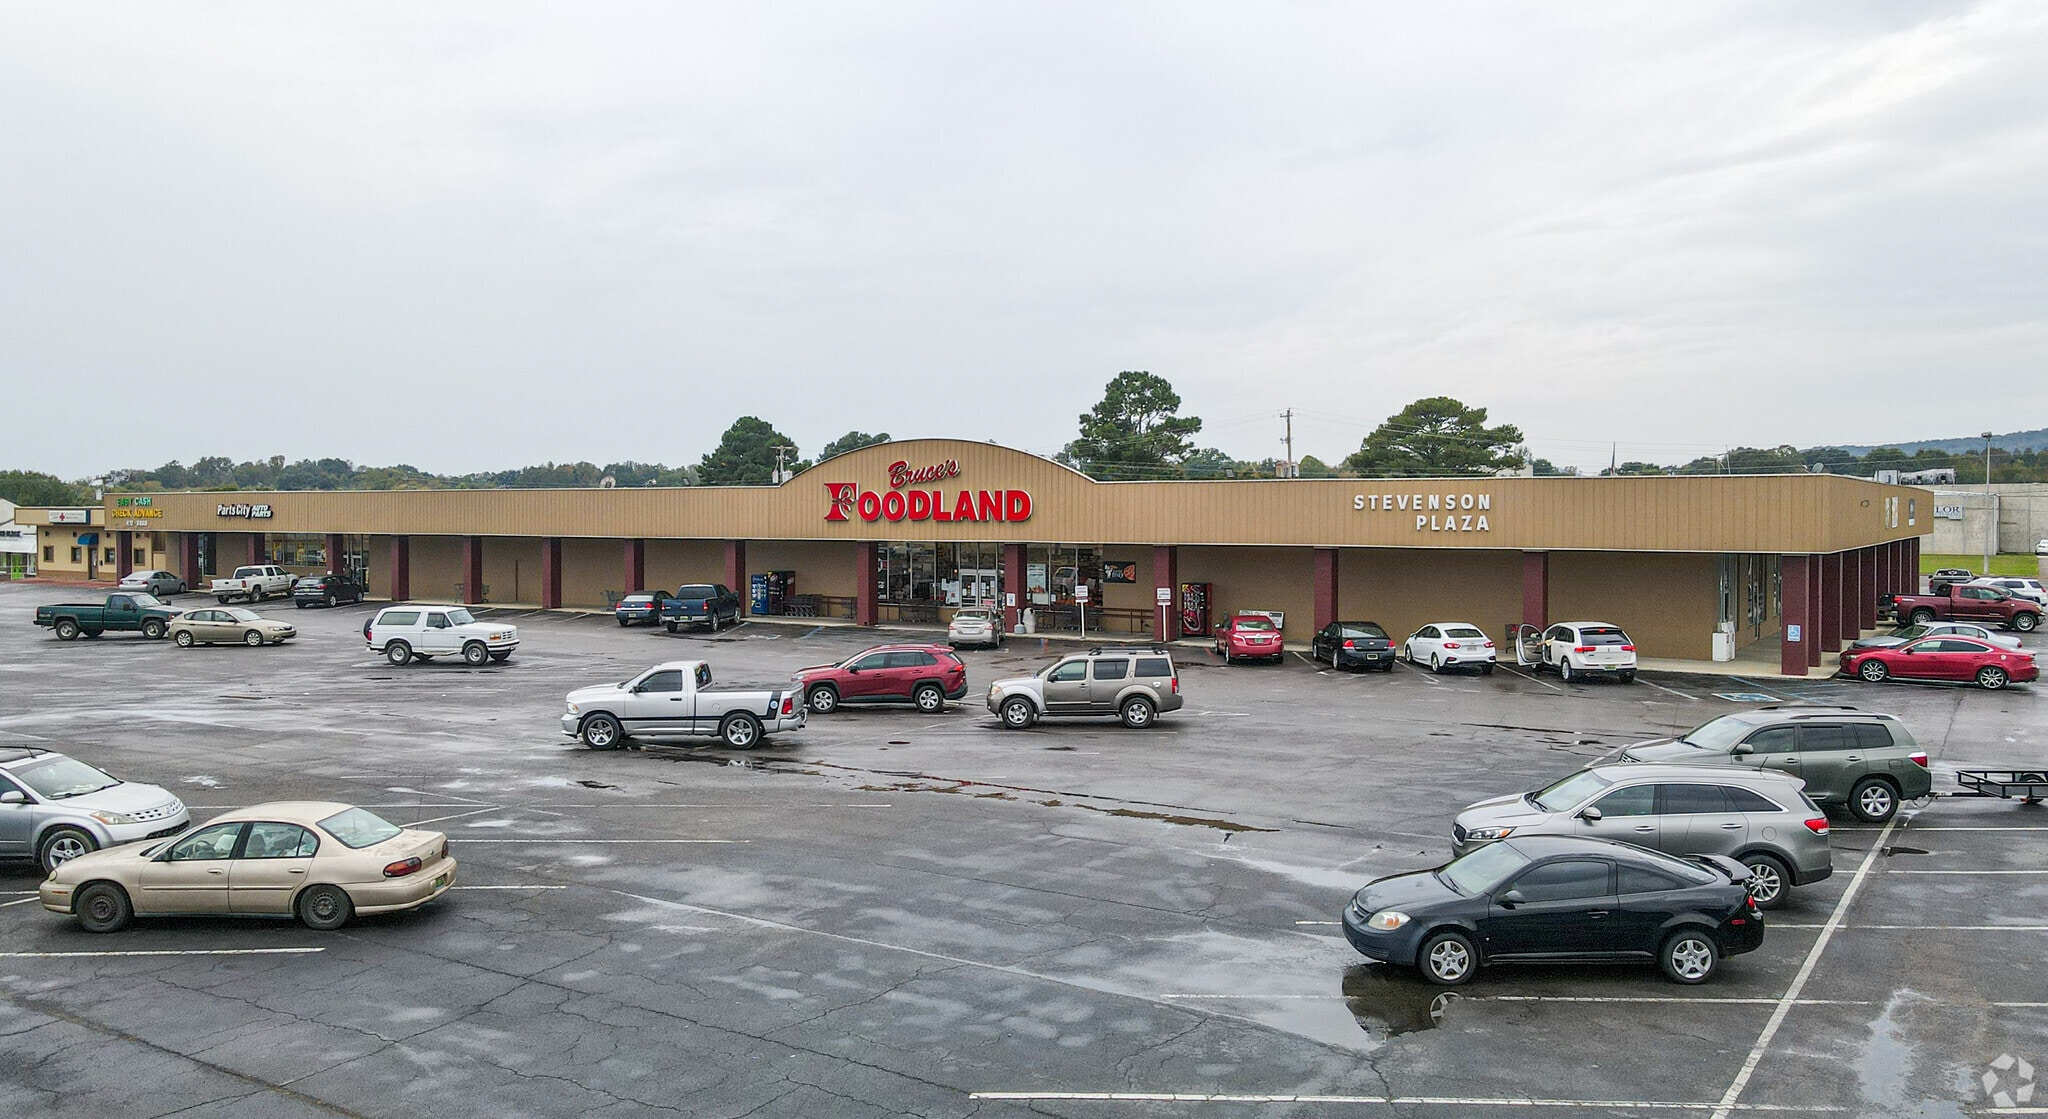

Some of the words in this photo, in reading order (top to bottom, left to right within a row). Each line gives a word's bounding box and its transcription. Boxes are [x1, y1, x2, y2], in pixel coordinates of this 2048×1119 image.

[888, 459, 960, 488] Bruce's
[135, 497, 152, 506] CASH
[824, 483, 1032, 521] FOODLAND
[1354, 494, 1490, 510] STEVENSON
[112, 509, 131, 517] CHECK
[134, 509, 162, 518] ADVANCE
[217, 504, 236, 516] Parts
[236, 504, 250, 518] City
[1416, 515, 1490, 531] PLAZA
